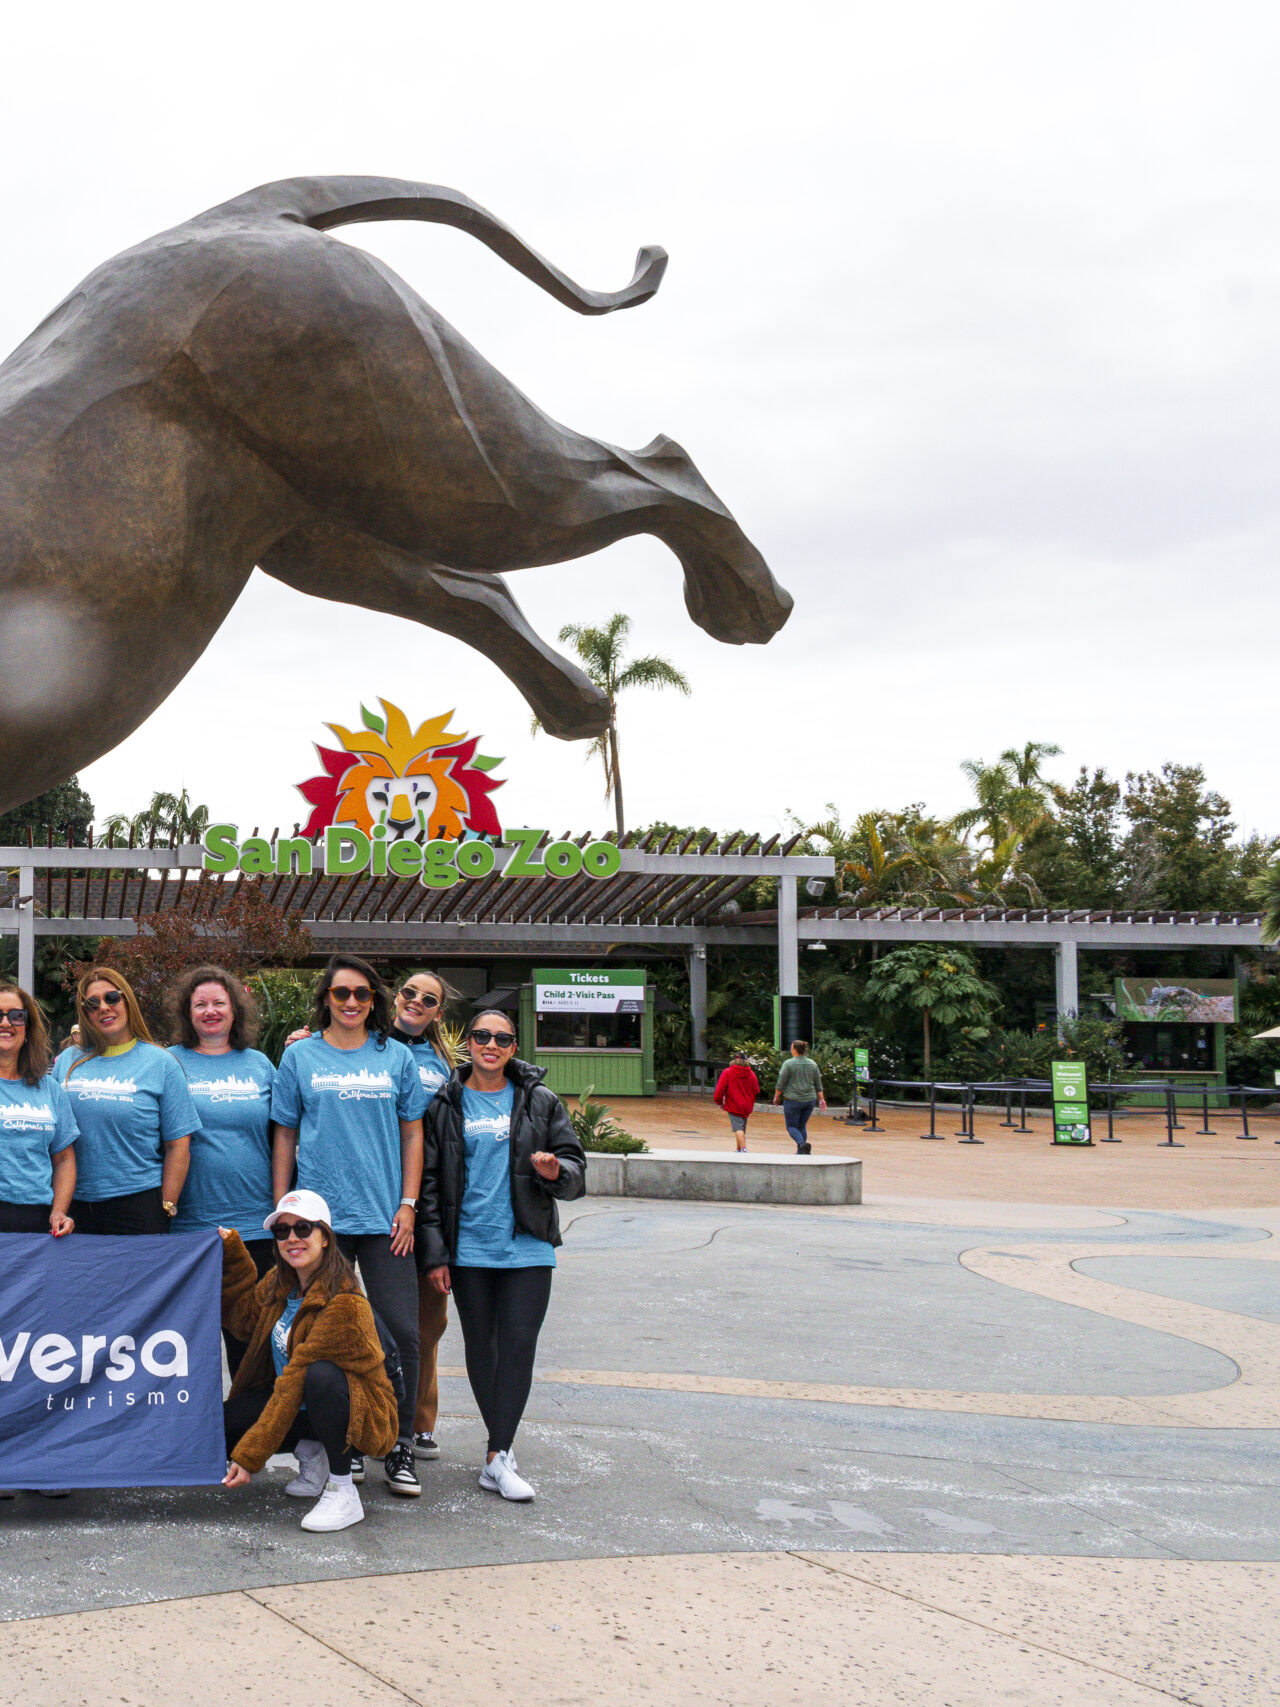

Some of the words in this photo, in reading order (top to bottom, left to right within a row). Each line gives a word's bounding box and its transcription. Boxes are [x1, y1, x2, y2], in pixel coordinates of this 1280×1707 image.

[202, 823, 313, 875] San
[324, 823, 497, 889] Diego
[501, 828, 622, 879] Zoo
[569, 972, 610, 983] Tickets
[543, 990, 566, 999] Child
[567, 990, 595, 999] 2-Visit
[596, 991, 615, 999] Pass
[631, 1014, 637, 1023] 7
[78, 1090, 117, 1102] California
[210, 1093, 249, 1103] California
[338, 1088, 378, 1101] California
[2, 1118, 44, 1132] California
[46, 1389, 190, 1411] turismo
